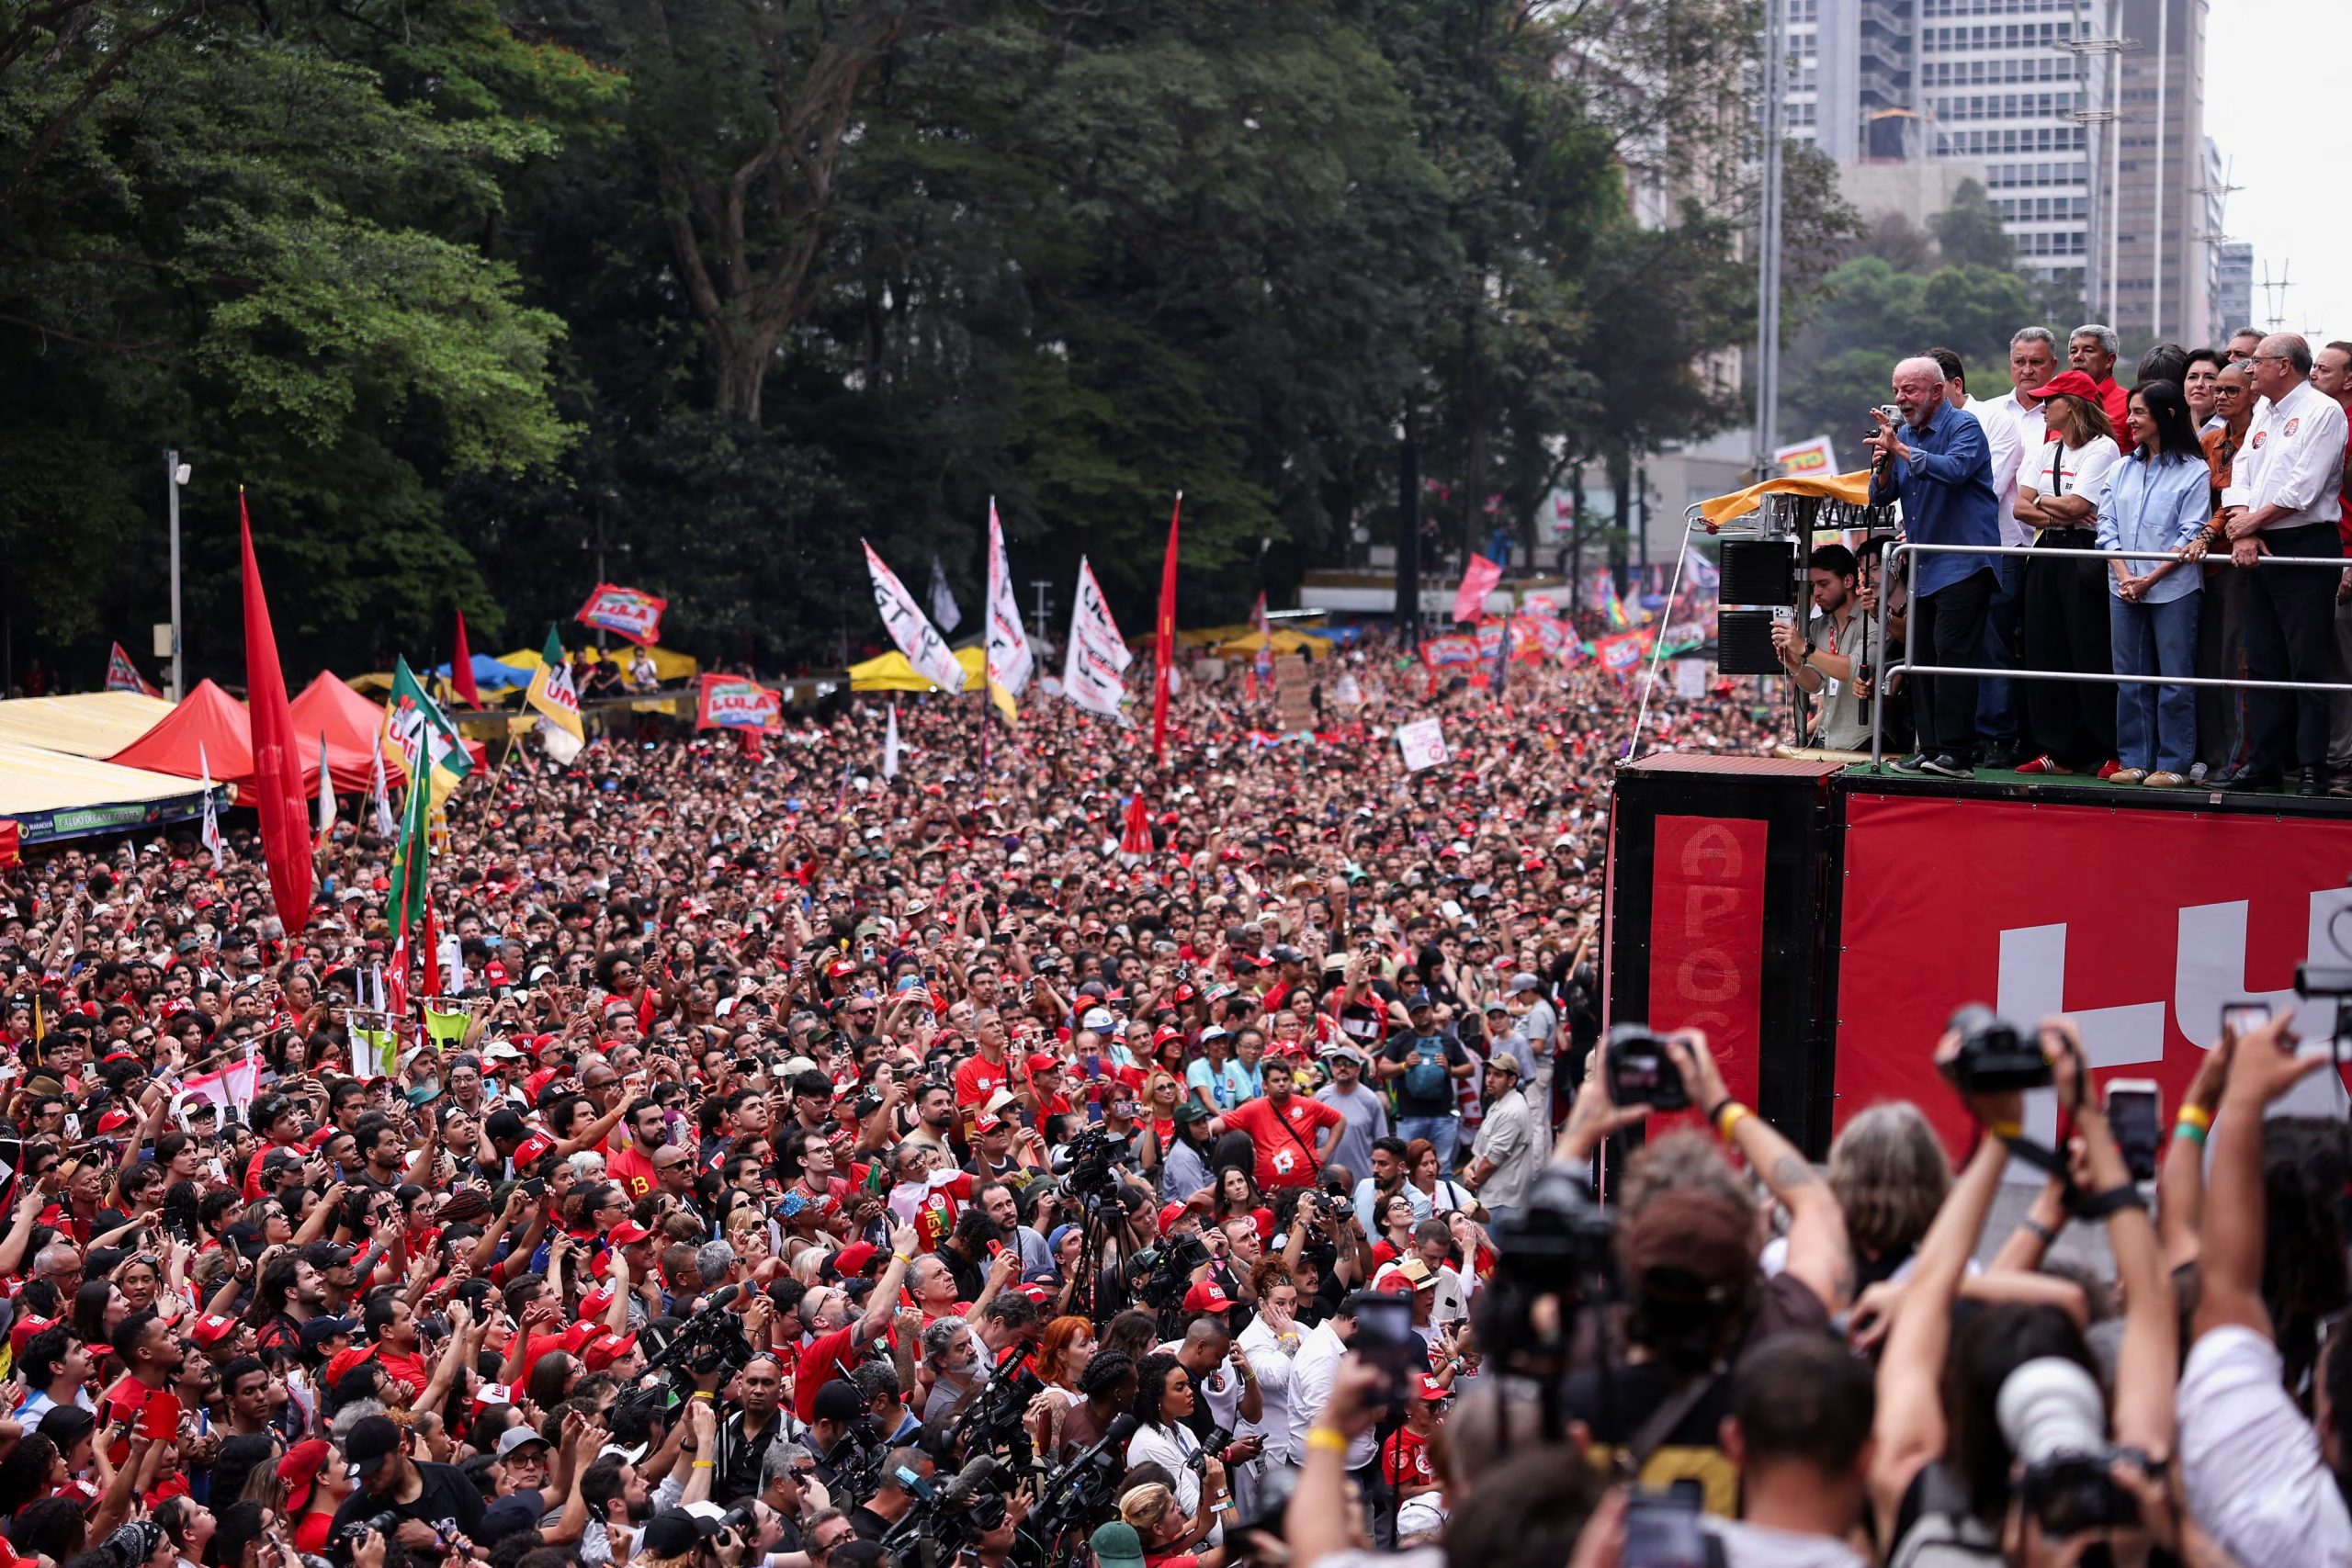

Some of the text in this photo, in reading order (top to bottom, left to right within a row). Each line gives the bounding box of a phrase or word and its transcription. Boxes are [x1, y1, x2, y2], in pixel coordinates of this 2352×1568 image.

[712, 696, 768, 711] LULA
[1272, 1150, 1294, 1174] 13
[631, 1176, 650, 1195] 13
[999, 1357, 1018, 1377] REUTERS
